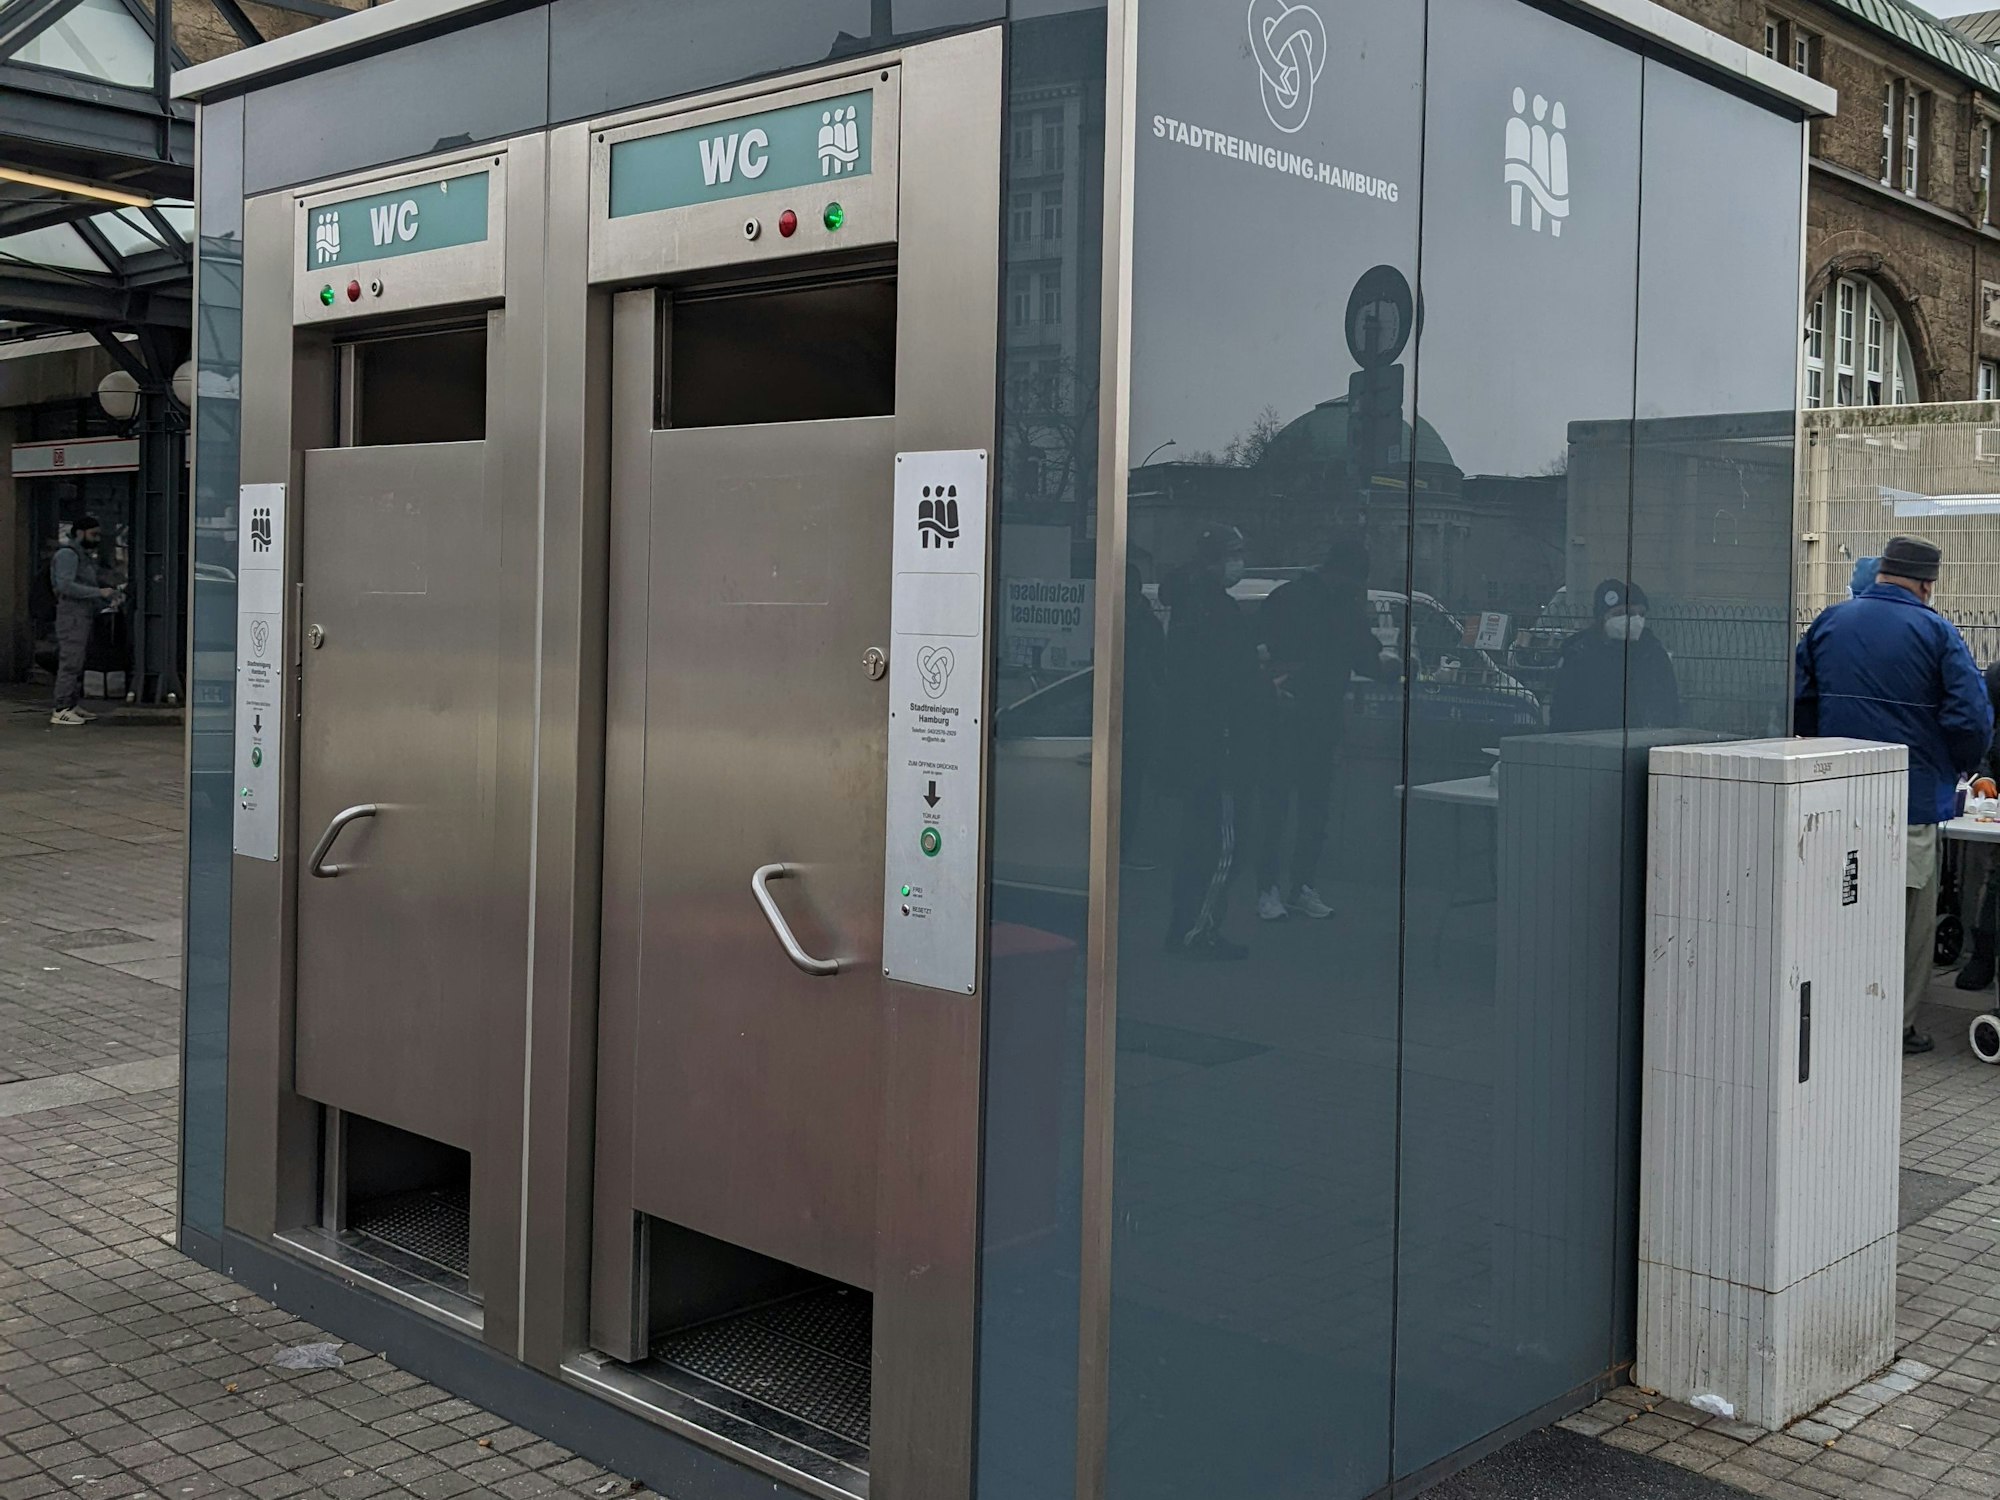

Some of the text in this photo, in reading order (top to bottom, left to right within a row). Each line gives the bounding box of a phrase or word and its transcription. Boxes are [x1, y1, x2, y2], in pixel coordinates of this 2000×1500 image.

[698, 128, 769, 186] WC
[1152, 114, 1399, 203] STADTREINIGUNG.HAMBURG
[370, 199, 419, 246] WC
[909, 702, 960, 716] Stadtreinigung
[918, 714, 950, 727] Hamburg
[918, 760, 936, 768] ÖFFNEN
[936, 761, 959, 771] DRÜCKEN
